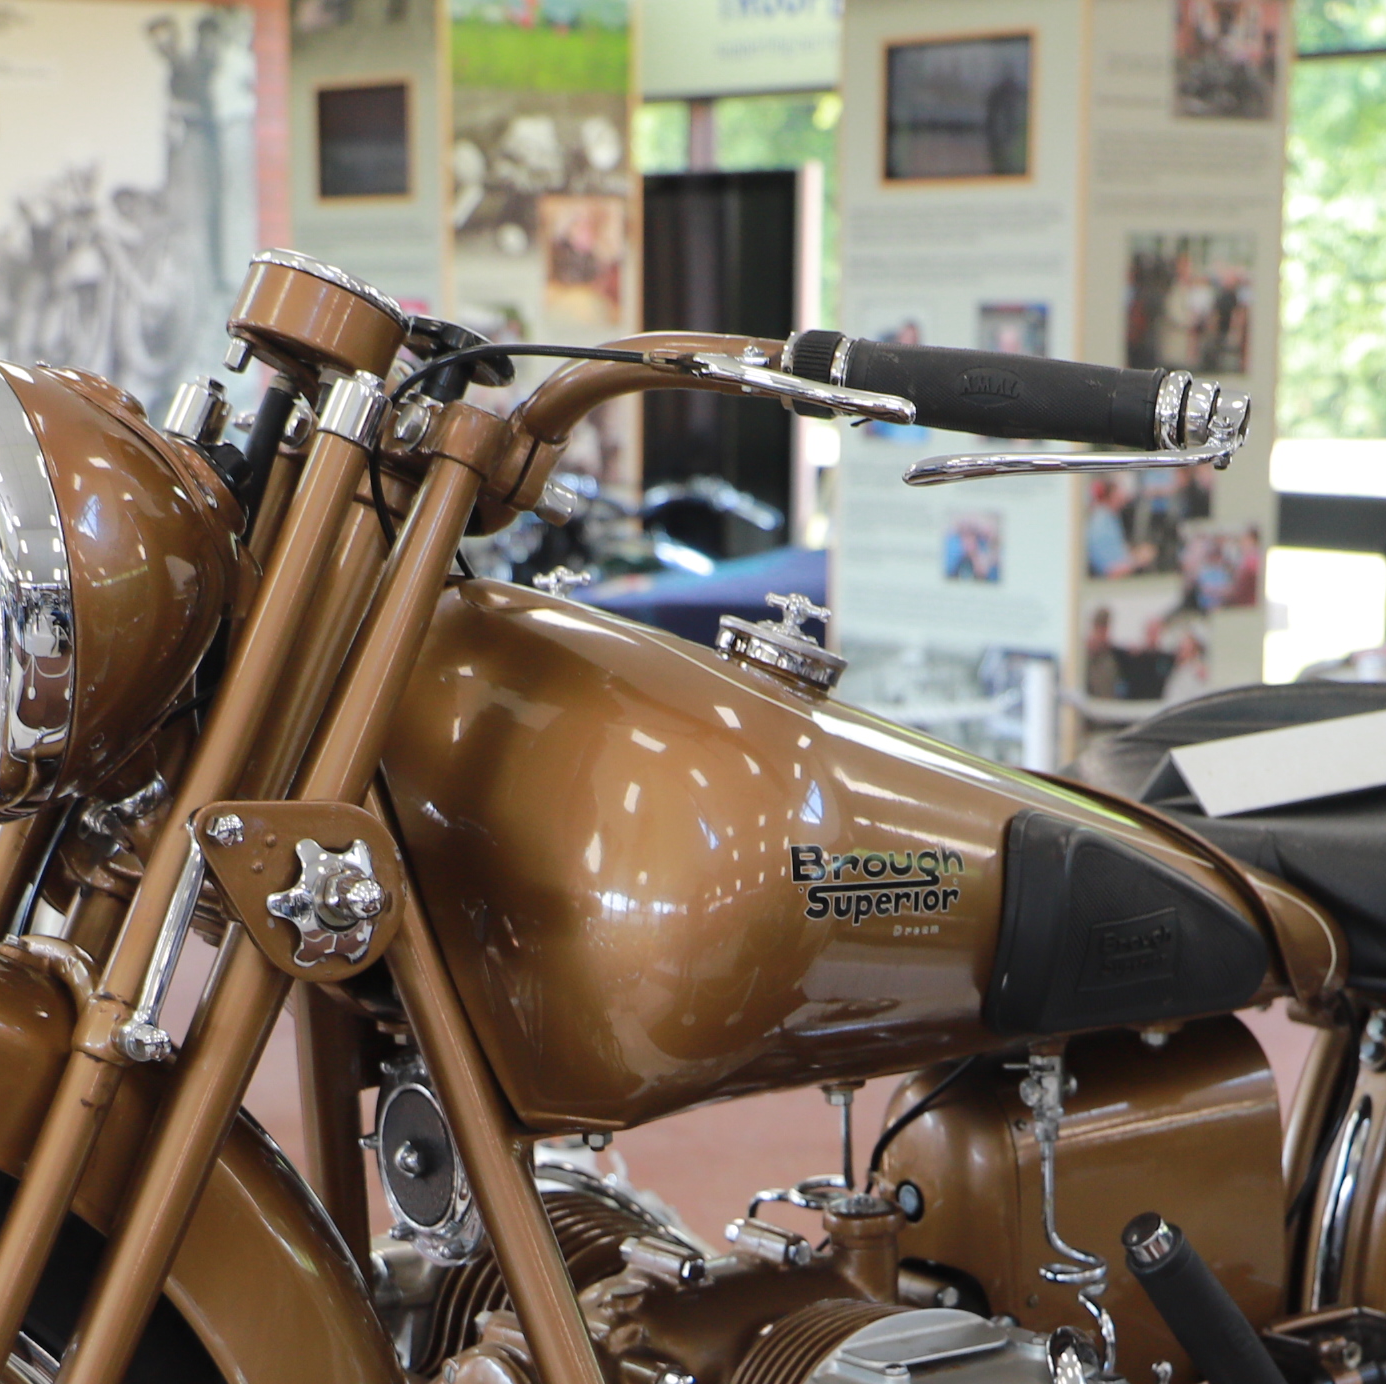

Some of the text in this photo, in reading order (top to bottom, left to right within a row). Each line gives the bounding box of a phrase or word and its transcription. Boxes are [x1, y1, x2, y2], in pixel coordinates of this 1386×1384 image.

[790, 841, 965, 885] Brough
[803, 884, 961, 926] Superior
[892, 924, 940, 937] Dream
